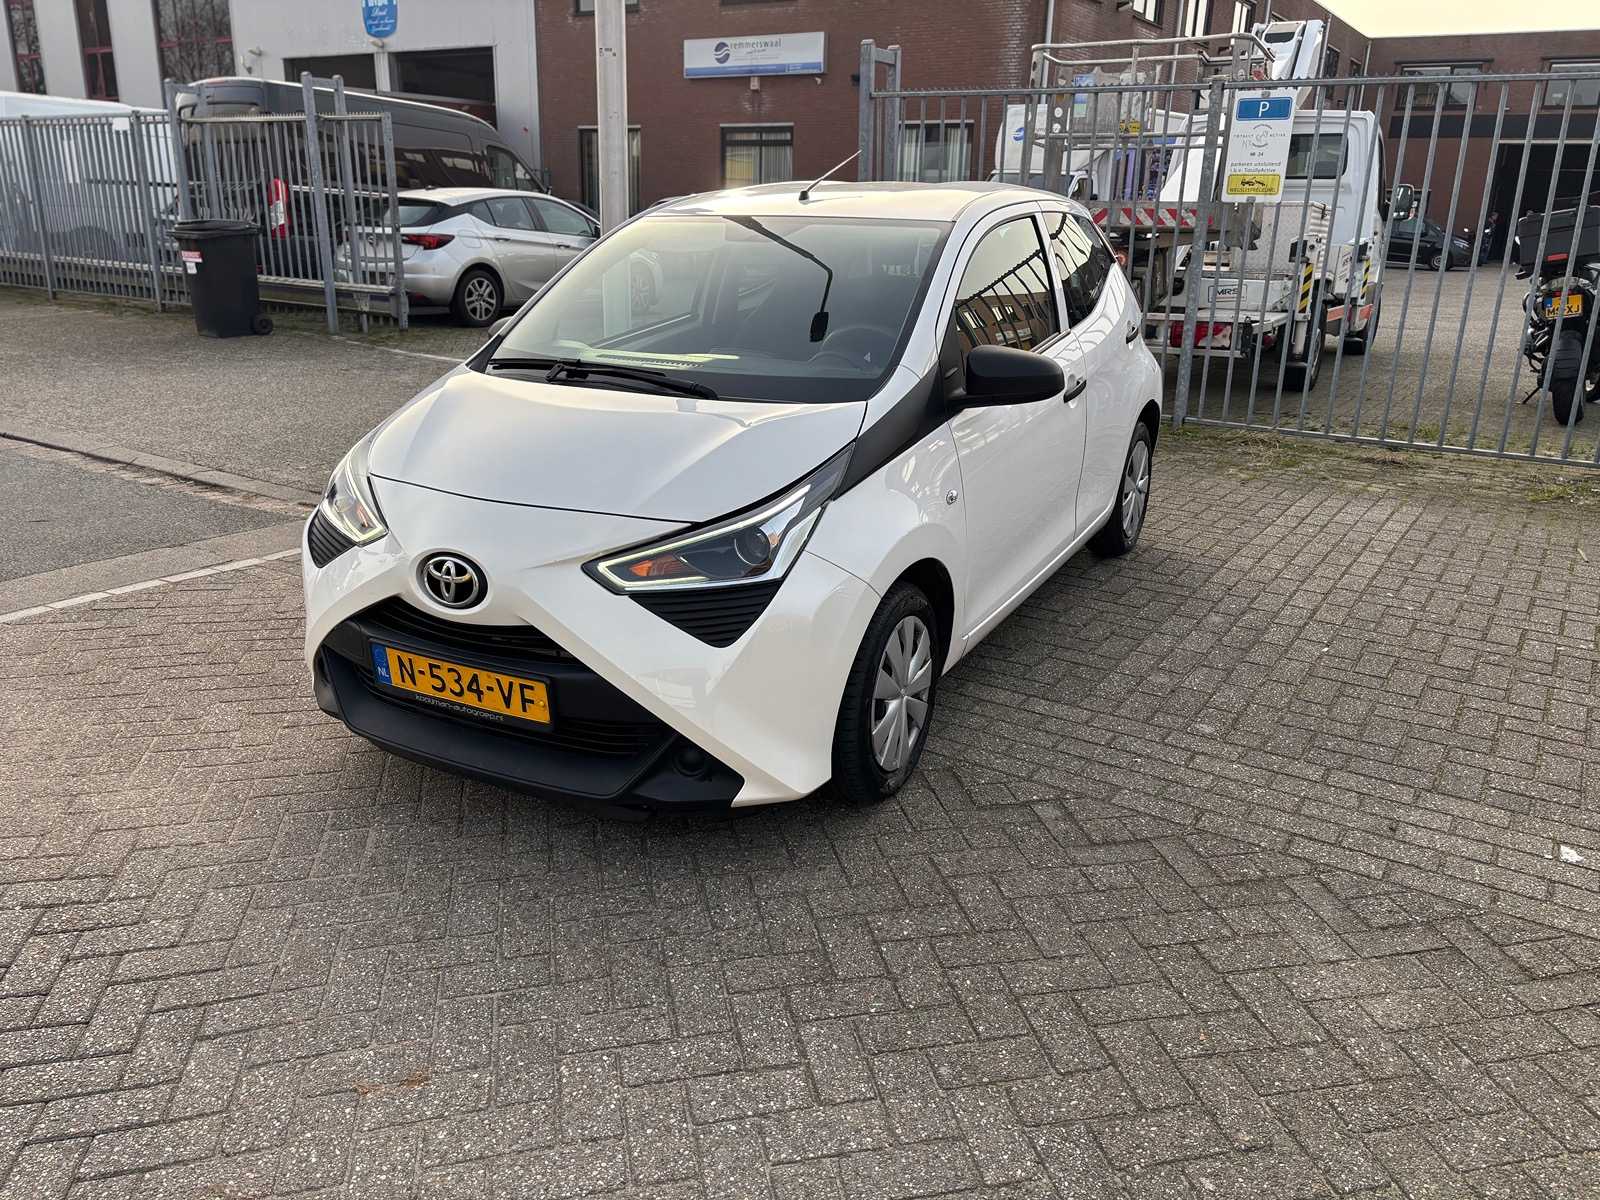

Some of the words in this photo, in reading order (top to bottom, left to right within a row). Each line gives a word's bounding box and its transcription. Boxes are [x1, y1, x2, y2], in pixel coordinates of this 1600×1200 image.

[730, 38, 782, 50] remmerswaal
[1258, 101, 1270, 118] P
[377, 667, 390, 678] NL
[397, 654, 536, 713] N-534-VF
